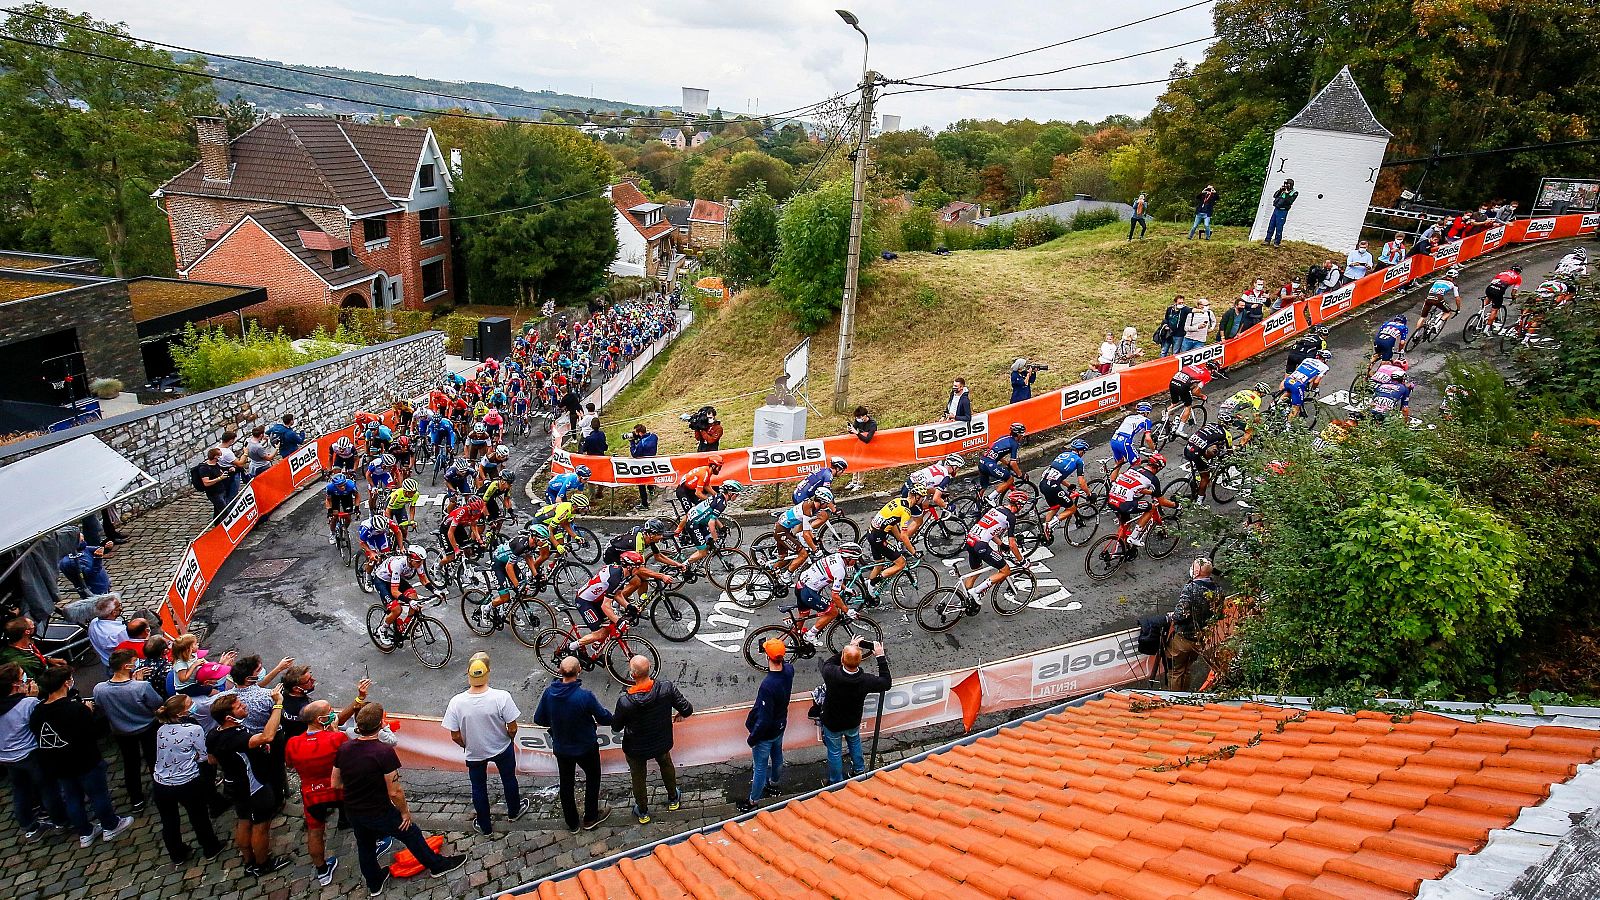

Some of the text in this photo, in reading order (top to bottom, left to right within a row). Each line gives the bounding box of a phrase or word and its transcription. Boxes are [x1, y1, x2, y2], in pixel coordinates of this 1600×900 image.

[1528, 221, 1554, 231] Boels
[1485, 230, 1504, 243] Boels
[1437, 245, 1460, 259] Boels
[1385, 263, 1411, 281] Boels
[1322, 289, 1353, 308] Boels
[1265, 312, 1294, 333] Boels
[1181, 345, 1223, 367] Boels
[1064, 380, 1119, 406] Boels
[1098, 396, 1119, 408] RENTAL
[918, 420, 985, 445] Boels
[962, 436, 985, 449] RENTAL
[290, 446, 317, 472] Boels
[752, 446, 822, 465] Boels
[615, 461, 671, 476] Boels
[654, 476, 674, 484] RENTAL
[681, 496, 691, 510] CCC
[693, 528, 706, 546] BORA
[176, 558, 198, 600] Boels
